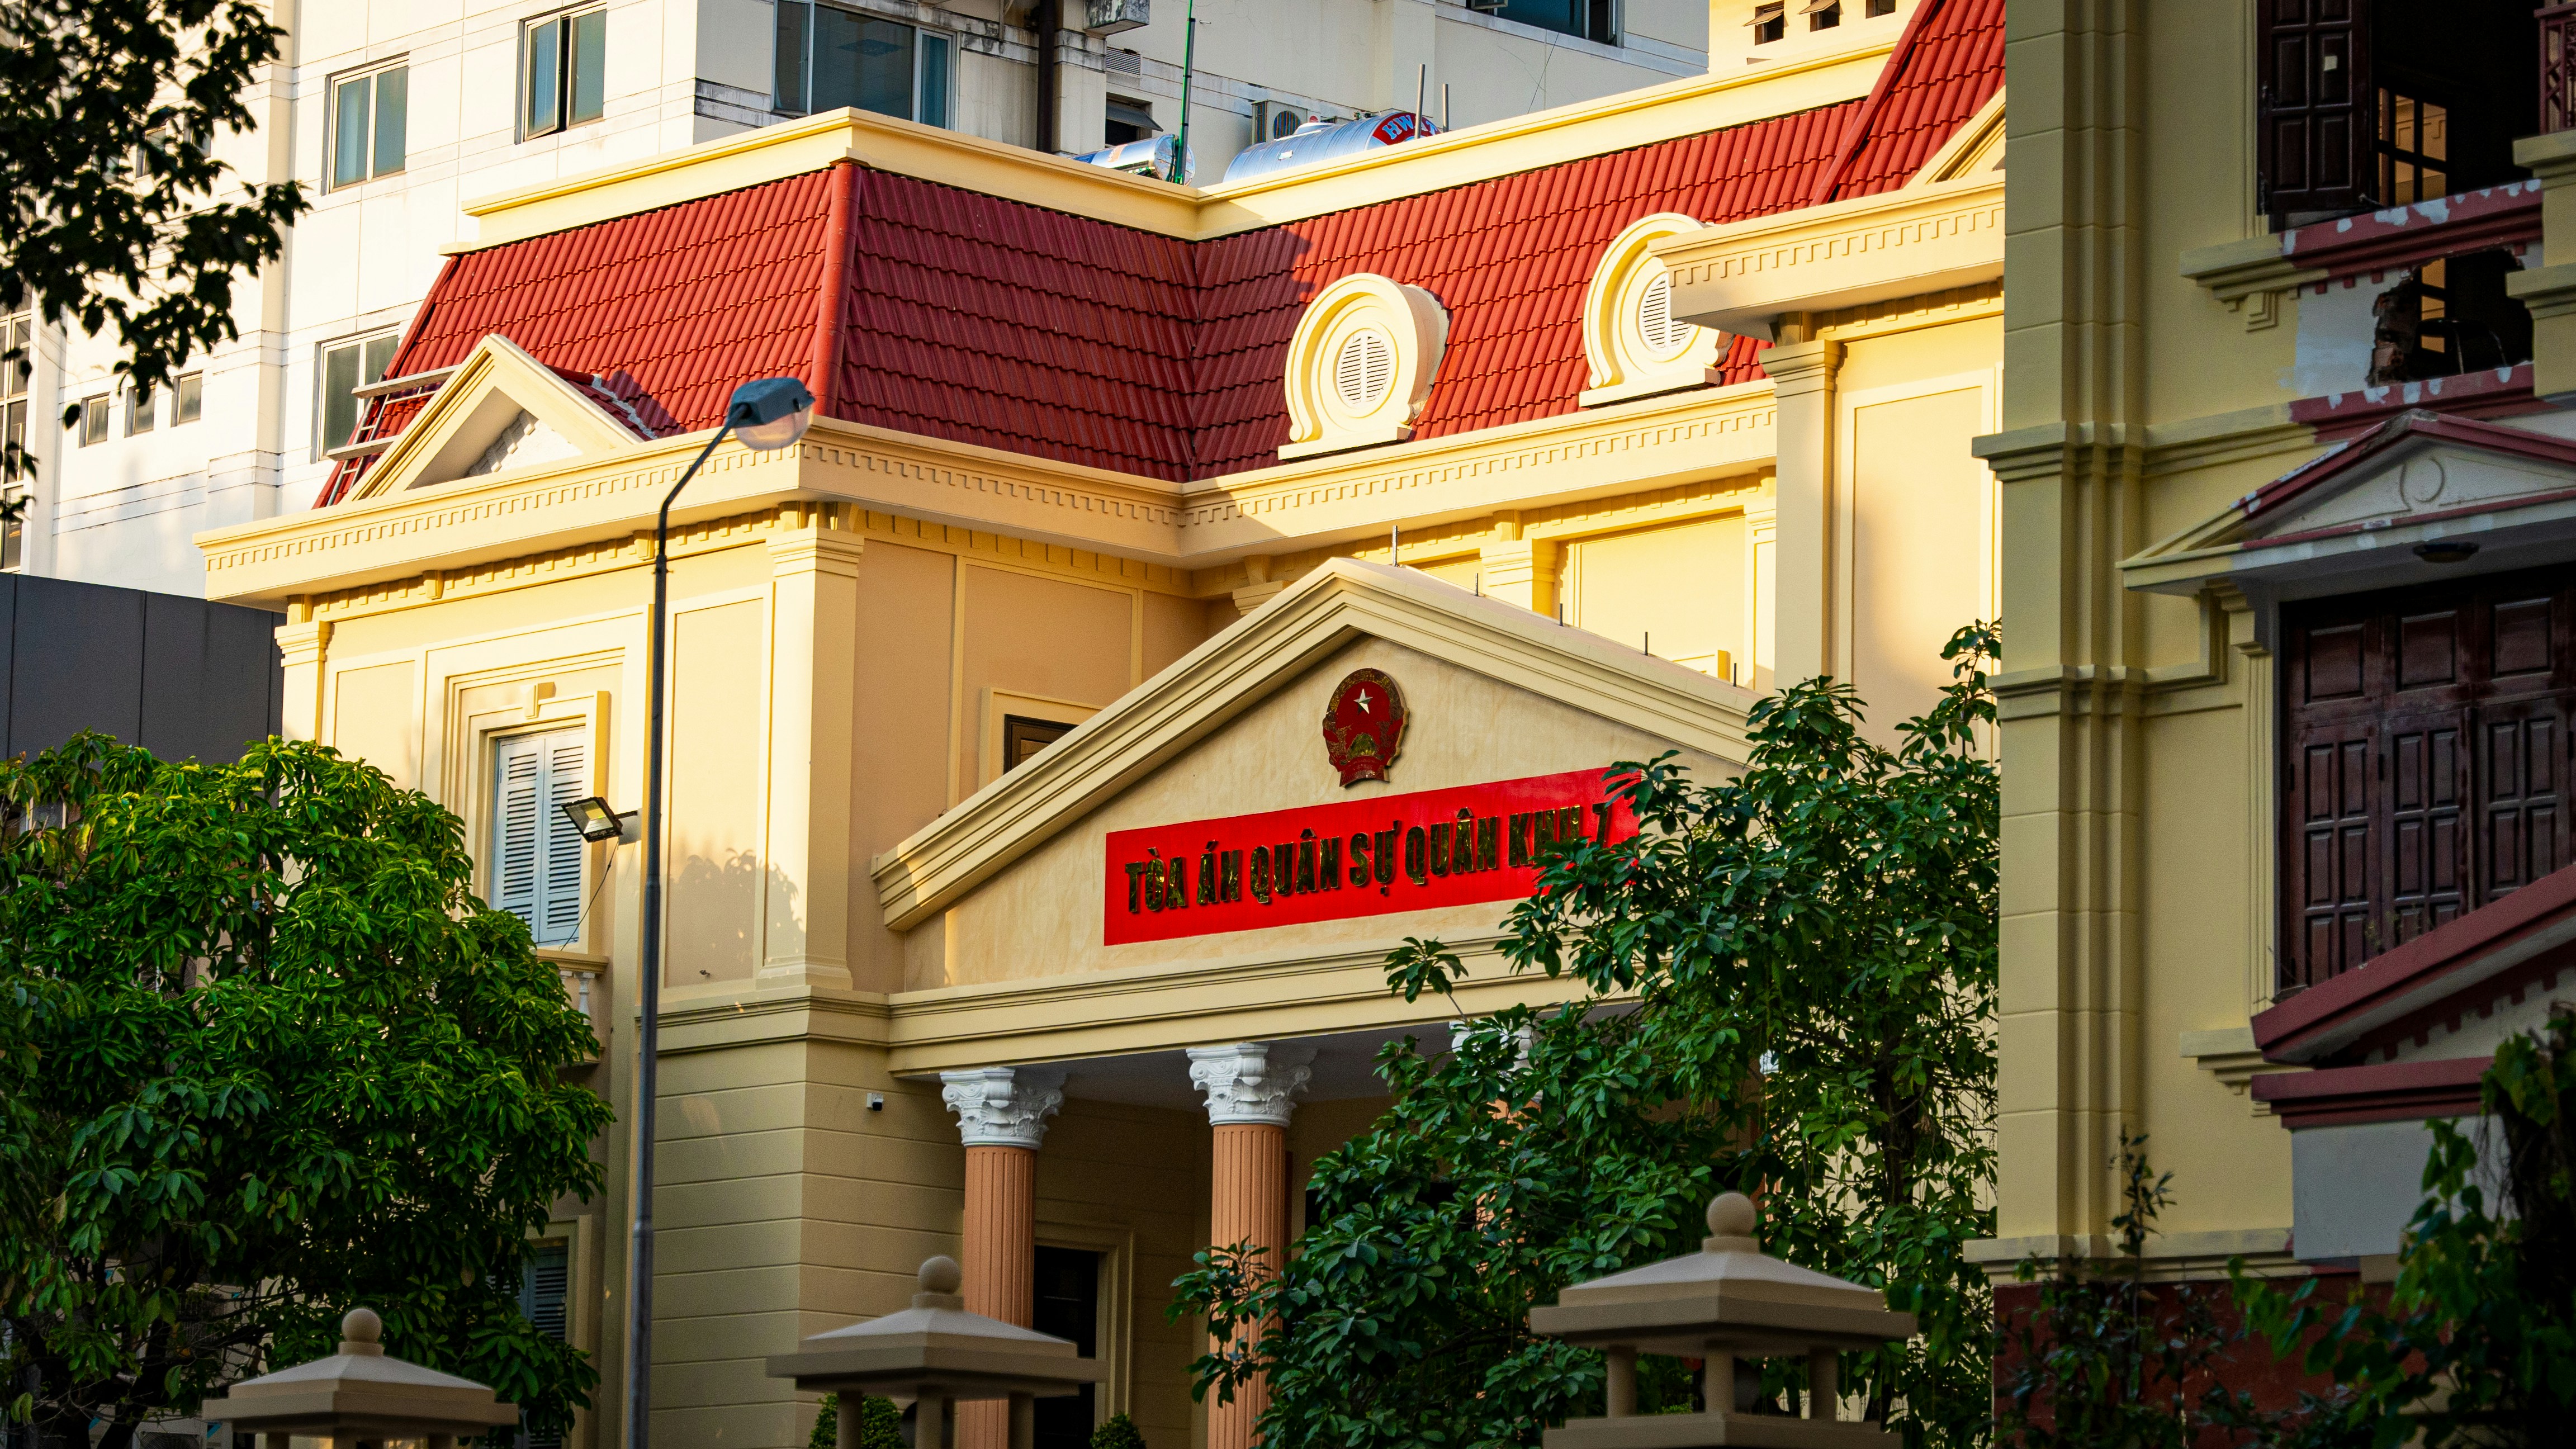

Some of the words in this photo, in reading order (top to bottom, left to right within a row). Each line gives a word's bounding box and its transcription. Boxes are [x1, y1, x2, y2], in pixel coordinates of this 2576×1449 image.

[1125, 846, 1186, 912] TÒA
[1196, 840, 1240, 905] ÁN
[1251, 827, 1340, 904] QUÂN
[1349, 820, 1399, 895] SỰ
[1405, 807, 1498, 885] QUÂN
[1592, 802, 1609, 849] 7
